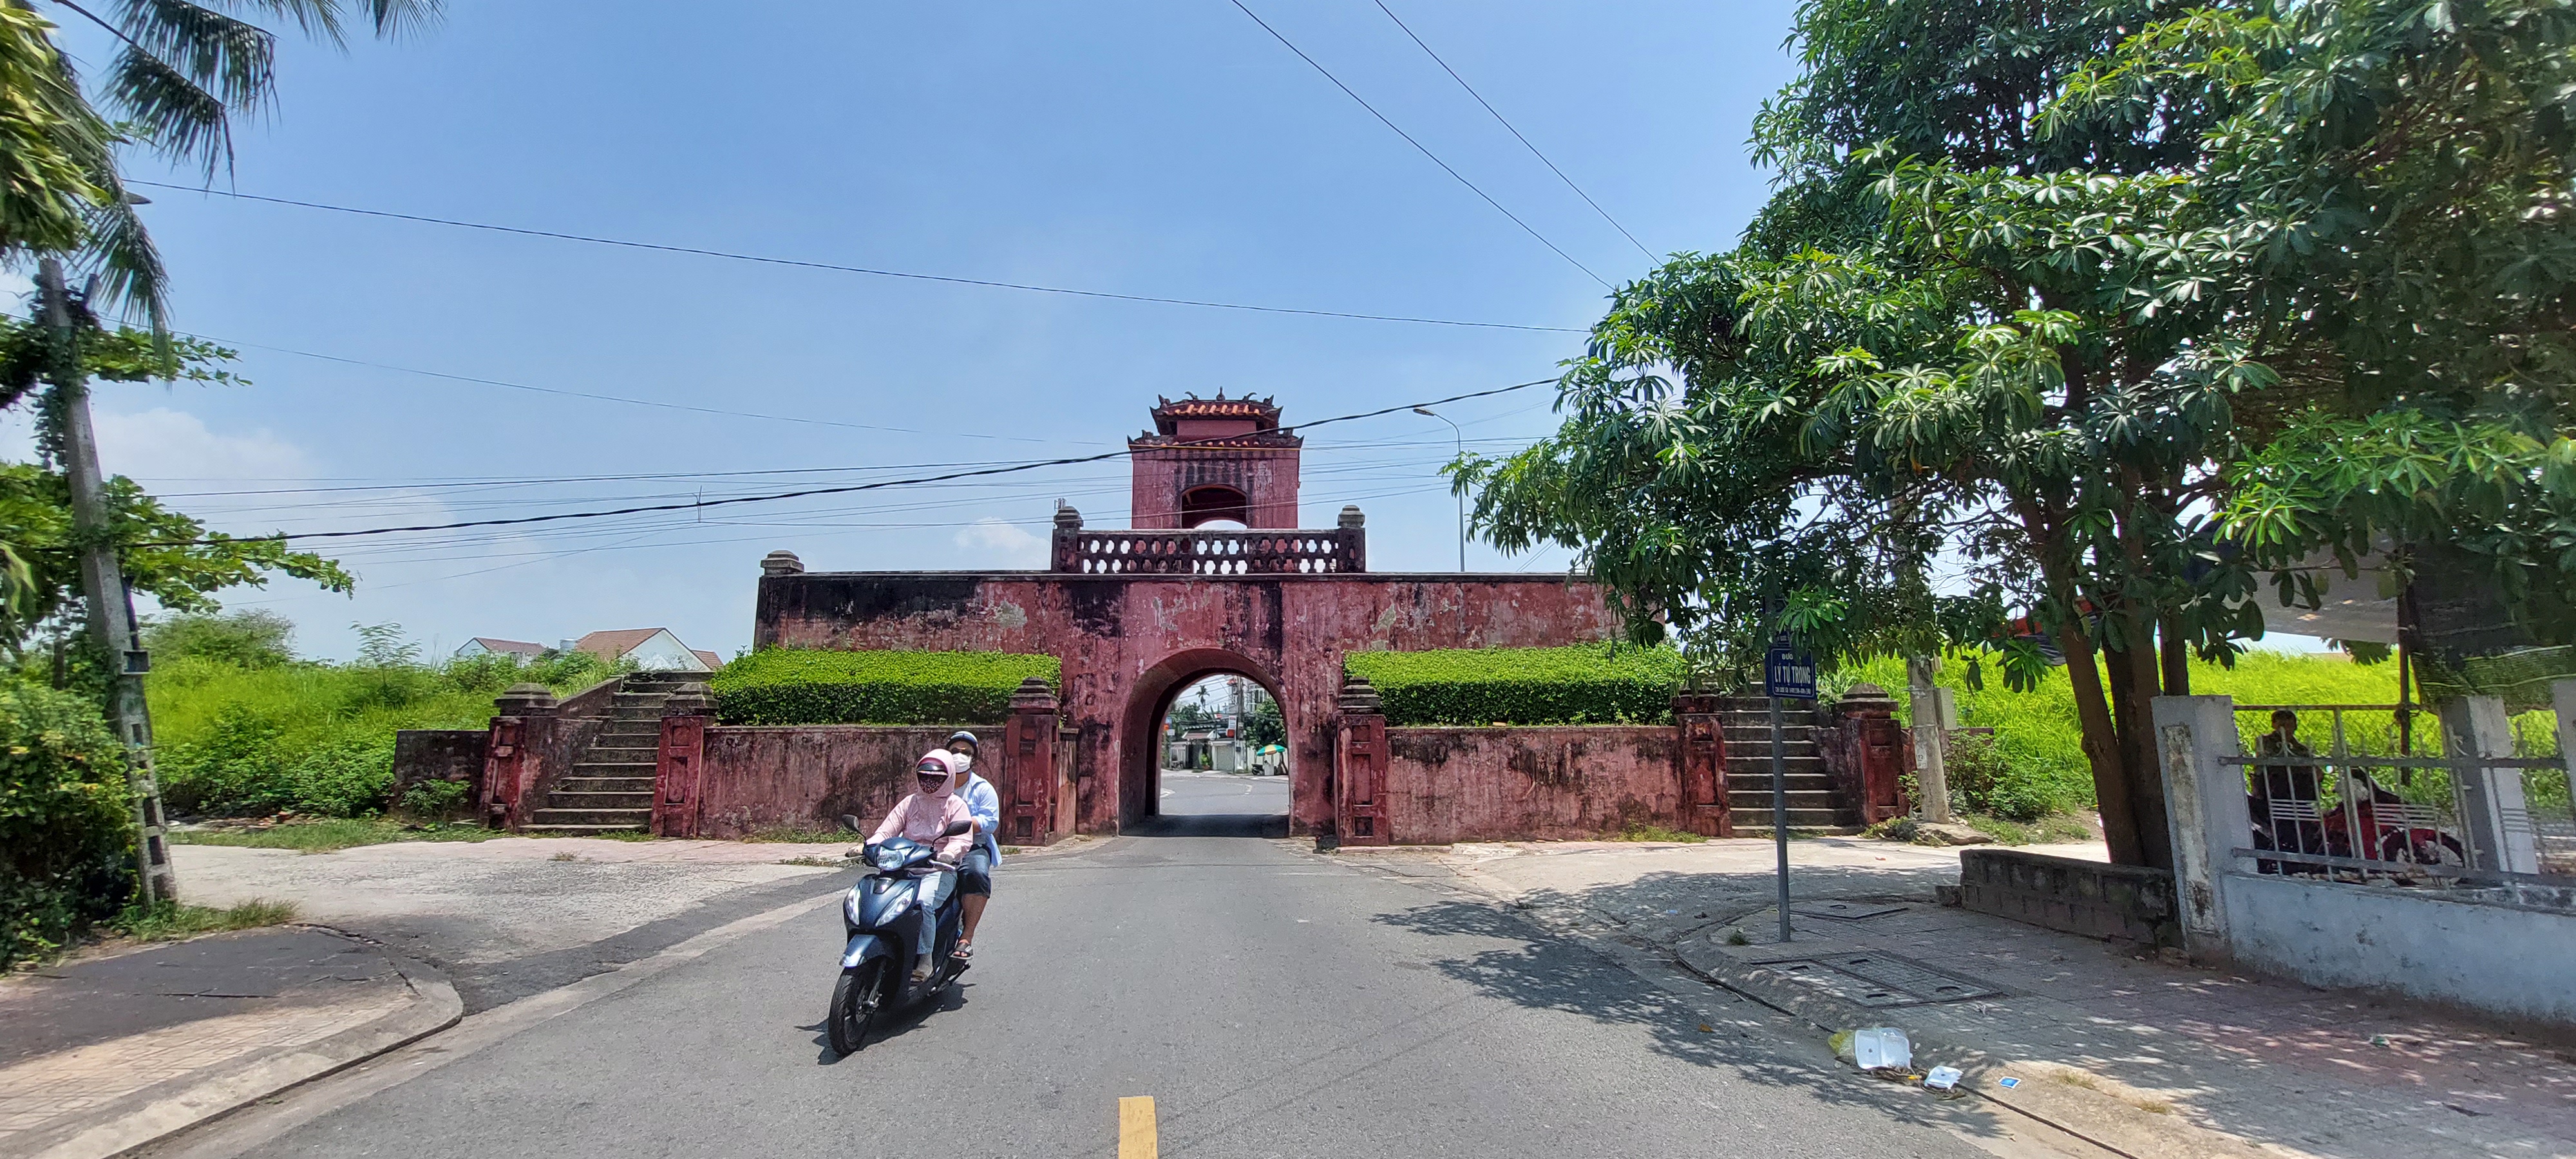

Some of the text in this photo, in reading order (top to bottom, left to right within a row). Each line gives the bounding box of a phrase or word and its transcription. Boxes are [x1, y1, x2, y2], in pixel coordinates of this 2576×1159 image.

[1774, 663, 1811, 686] LÝ TỰ TRỌNG
